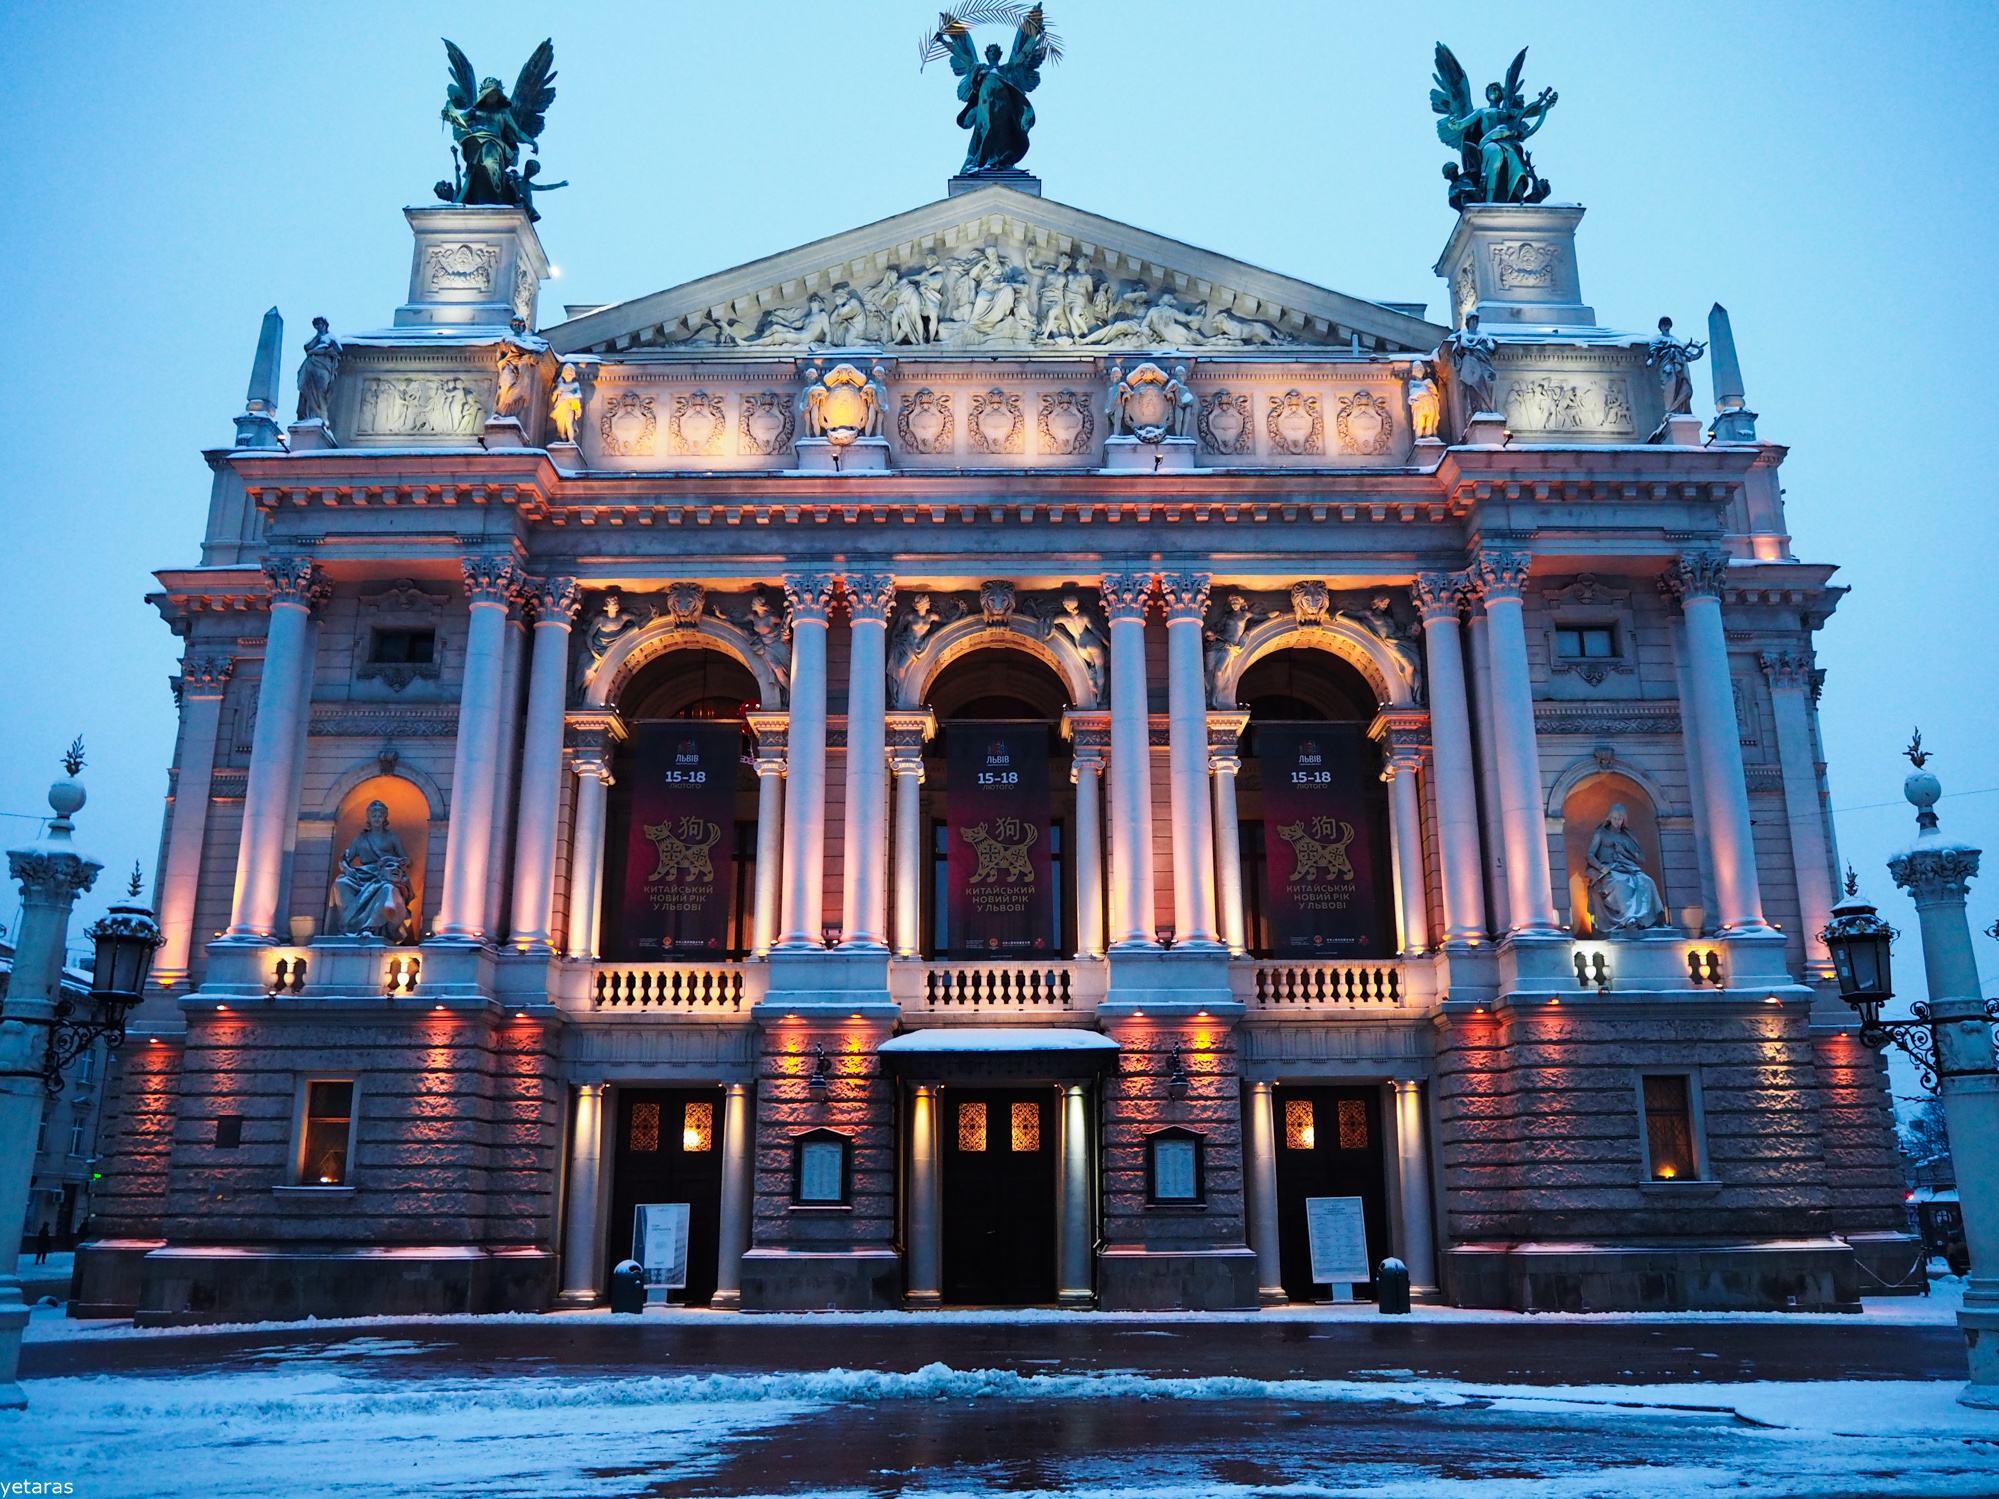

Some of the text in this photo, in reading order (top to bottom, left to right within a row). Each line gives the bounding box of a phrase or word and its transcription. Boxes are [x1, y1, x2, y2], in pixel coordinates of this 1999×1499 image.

[675, 754, 699, 763] ЛЬВІВ
[986, 755, 1010, 764] ЛЬВІВ
[1299, 755, 1321, 763] ЛЬВІВ
[679, 816, 703, 840] 狗
[996, 817, 1020, 841] 狗
[1312, 816, 1336, 839] 狗
[643, 885, 713, 894] КИТАЙСЬКИЙ
[966, 885, 1035, 894] КИТАЙСЬКИЙ
[1286, 884, 1355, 893] КИТАЙСЬКИЙ
[650, 894, 687, 902] НОВИЙ
[973, 894, 1010, 903] НОВИЙ
[1294, 892, 1350, 901] НОВИЙ РІК
[653, 903, 701, 911] У ЛЬВОВІ
[977, 904, 1025, 912] У ЛЬВОВІ
